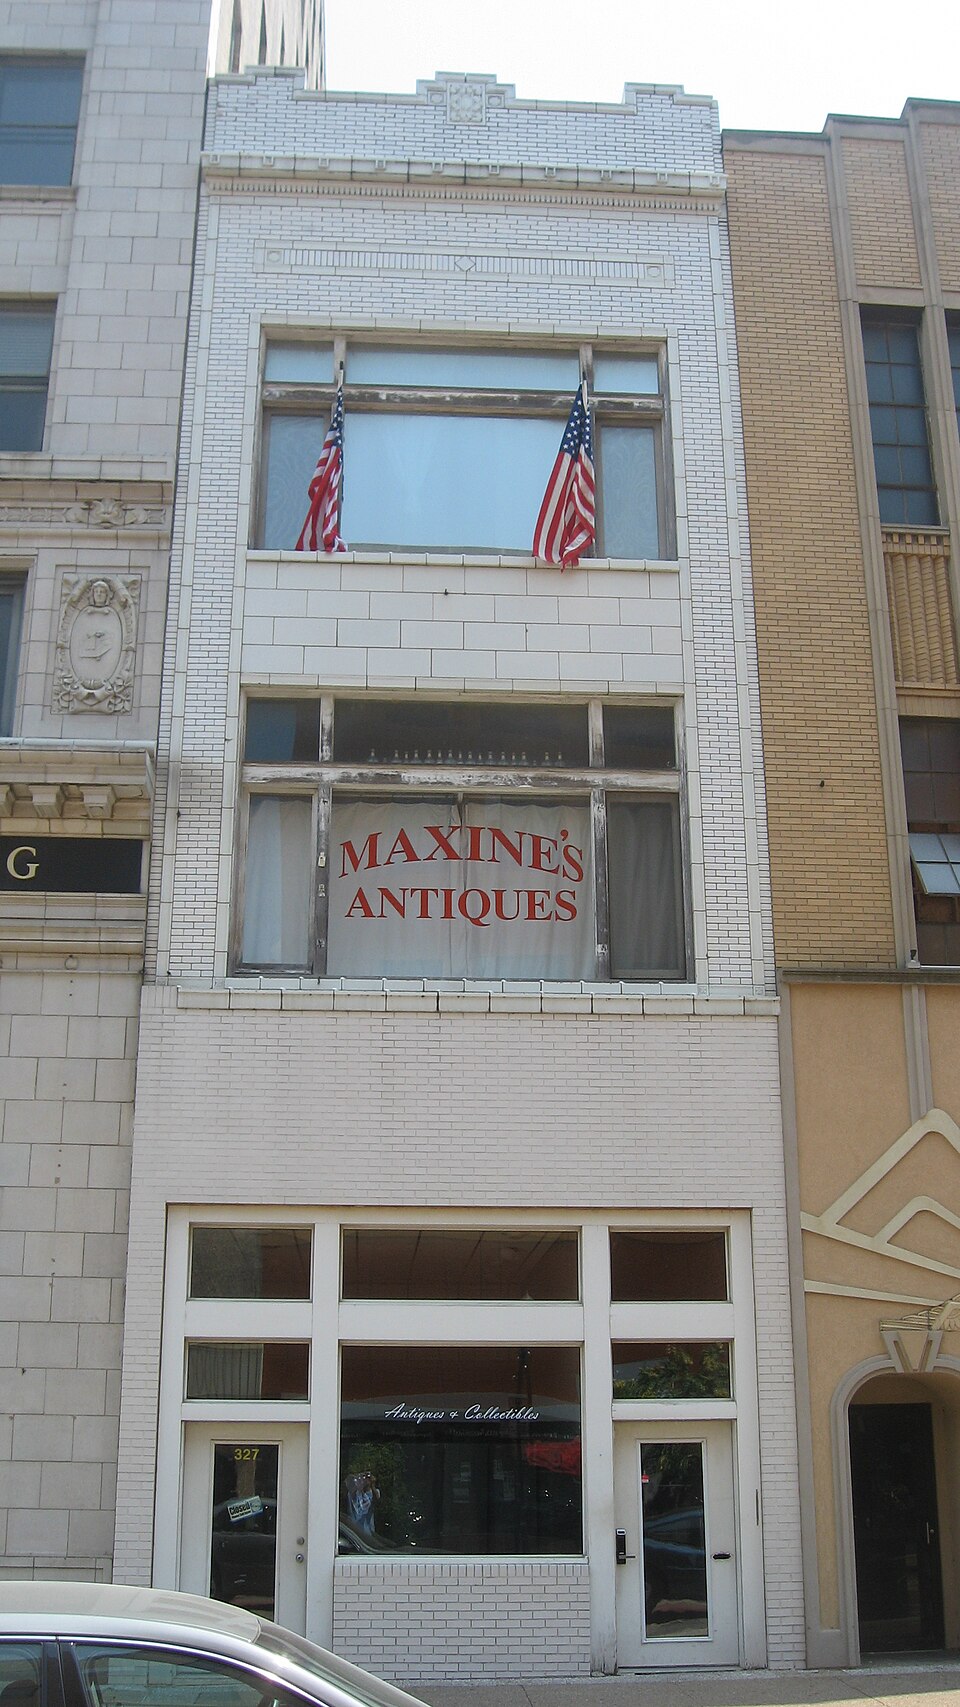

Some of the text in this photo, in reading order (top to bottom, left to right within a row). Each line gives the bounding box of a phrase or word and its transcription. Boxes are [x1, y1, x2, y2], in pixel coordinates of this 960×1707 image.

[6, 846, 40, 880] G
[338, 825, 584, 883] MAXINE'S
[344, 886, 578, 927] ANTIQUES
[384, 1402, 539, 1424] Antiques & Collectibles
[234, 1448, 260, 1461] 327
